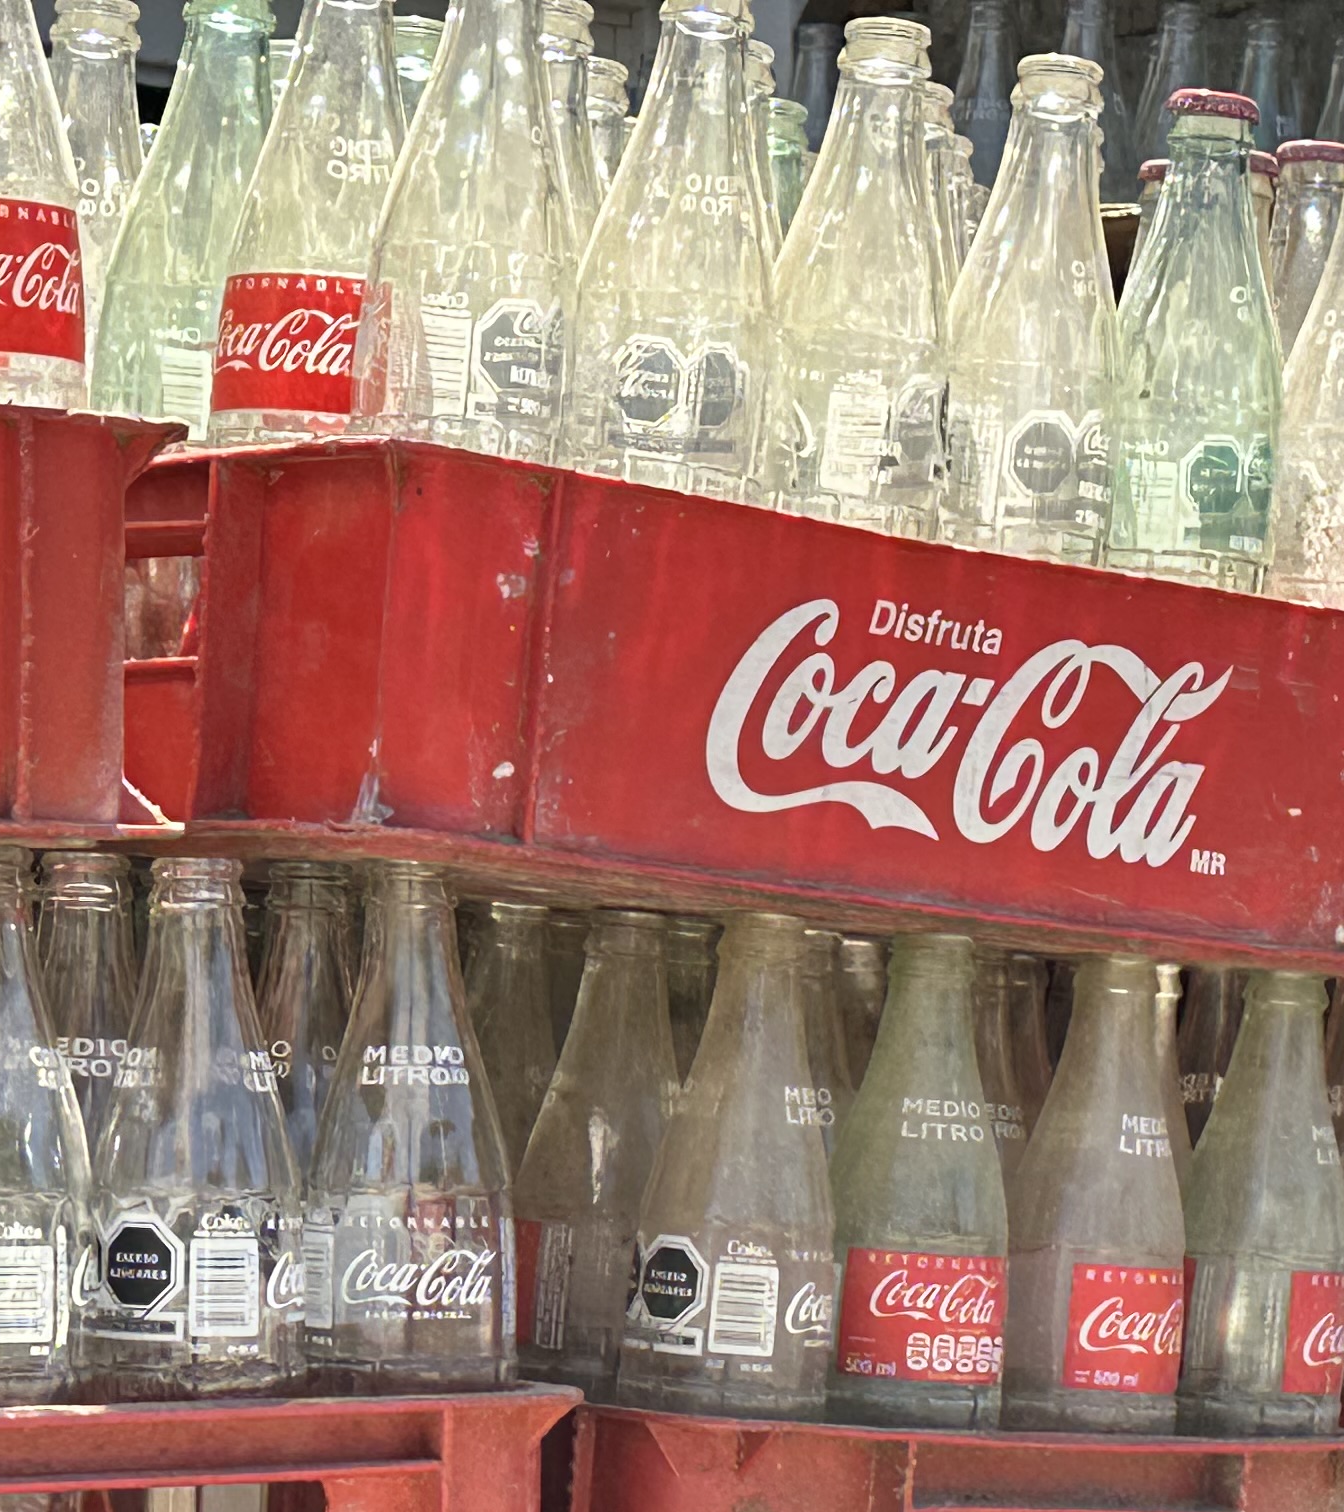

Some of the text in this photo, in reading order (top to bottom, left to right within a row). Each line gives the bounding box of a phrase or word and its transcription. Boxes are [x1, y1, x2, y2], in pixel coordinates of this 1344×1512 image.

[868, 598, 1004, 657] Disfruta
[705, 597, 1234, 868] Coca-Cola
[1189, 848, 1227, 876] MR
[901, 1096, 982, 1120] MEDIO
[899, 1120, 985, 1143] LITRO
[868, 1269, 1001, 1326] Coca-Cola
